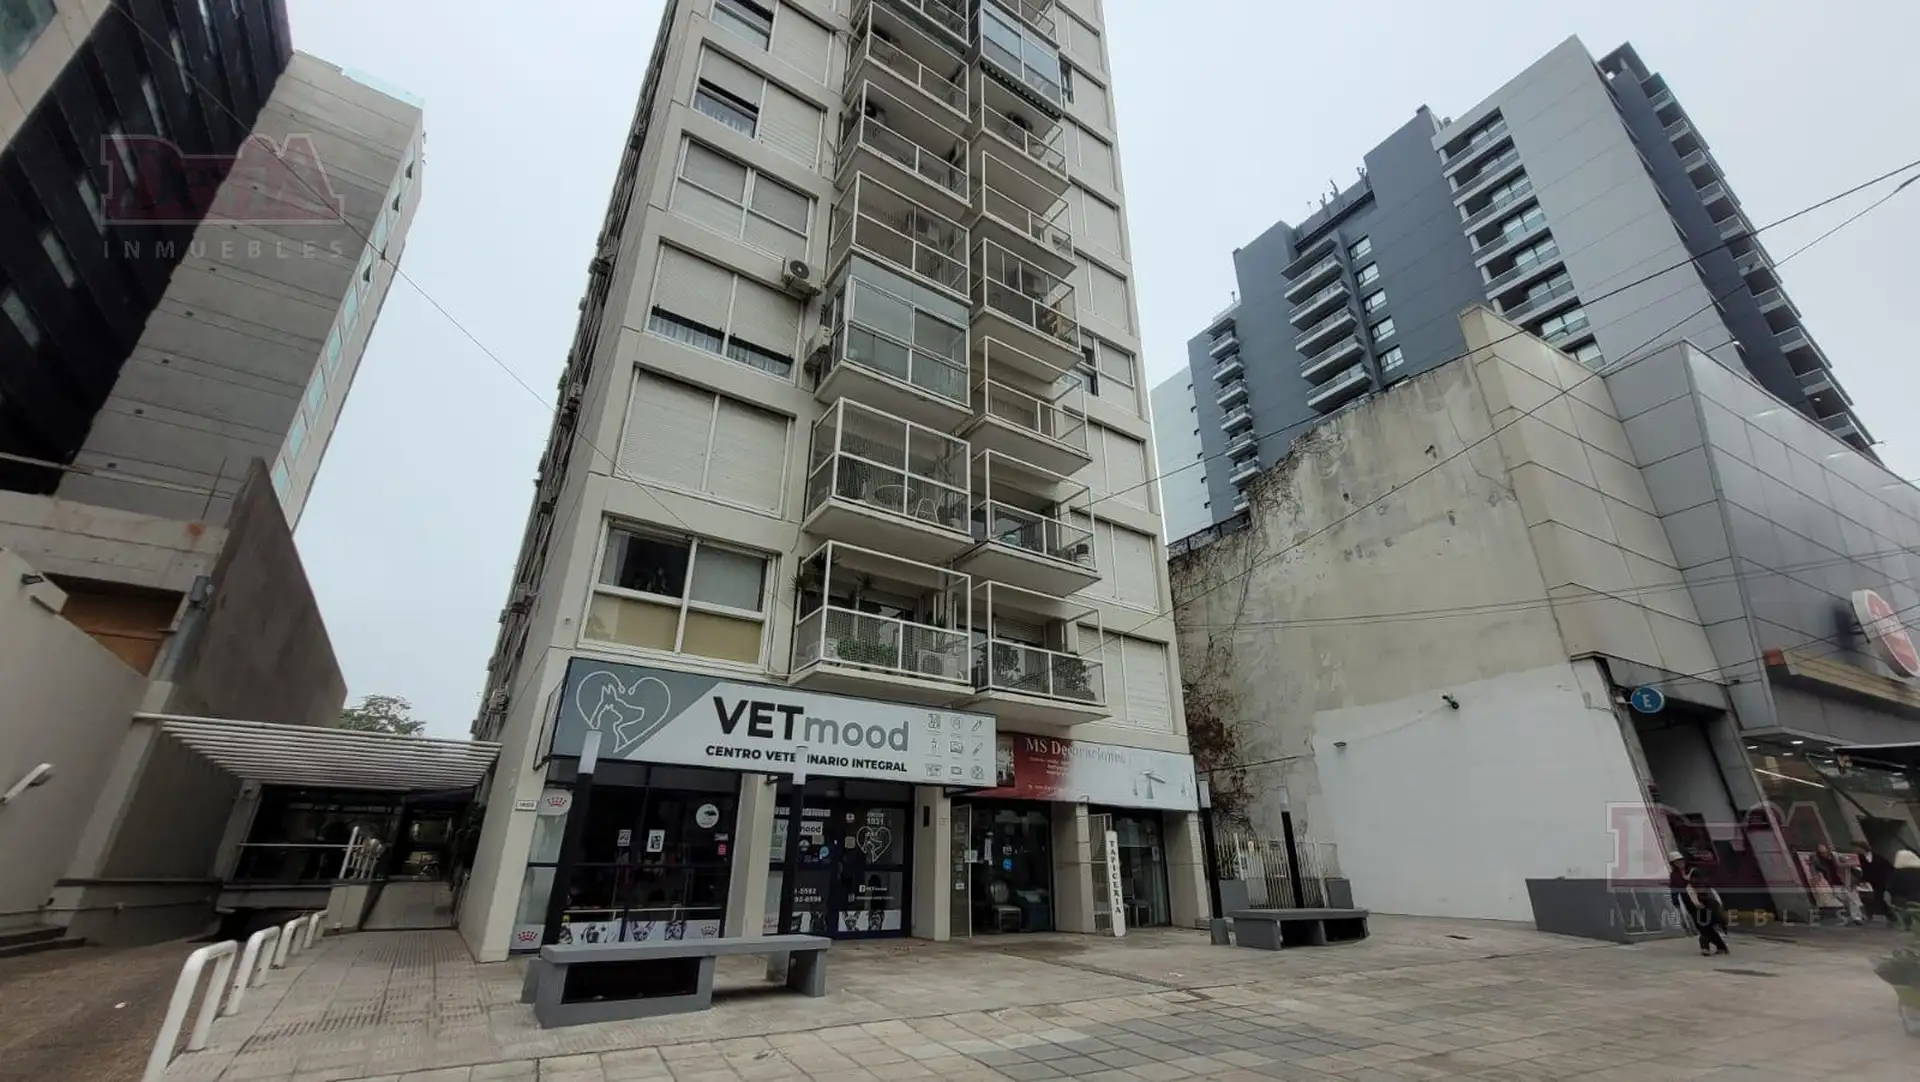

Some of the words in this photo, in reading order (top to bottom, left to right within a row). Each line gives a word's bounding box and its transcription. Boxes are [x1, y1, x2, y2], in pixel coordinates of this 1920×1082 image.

[713, 696, 909, 752] VETmood
[706, 745, 761, 761] CENTRO
[766, 751, 849, 768] VETEINARIO
[852, 760, 907, 772] INTEGRAL
[1026, 738, 1048, 754] MS
[1109, 841, 1121, 913] TAPICERIA
